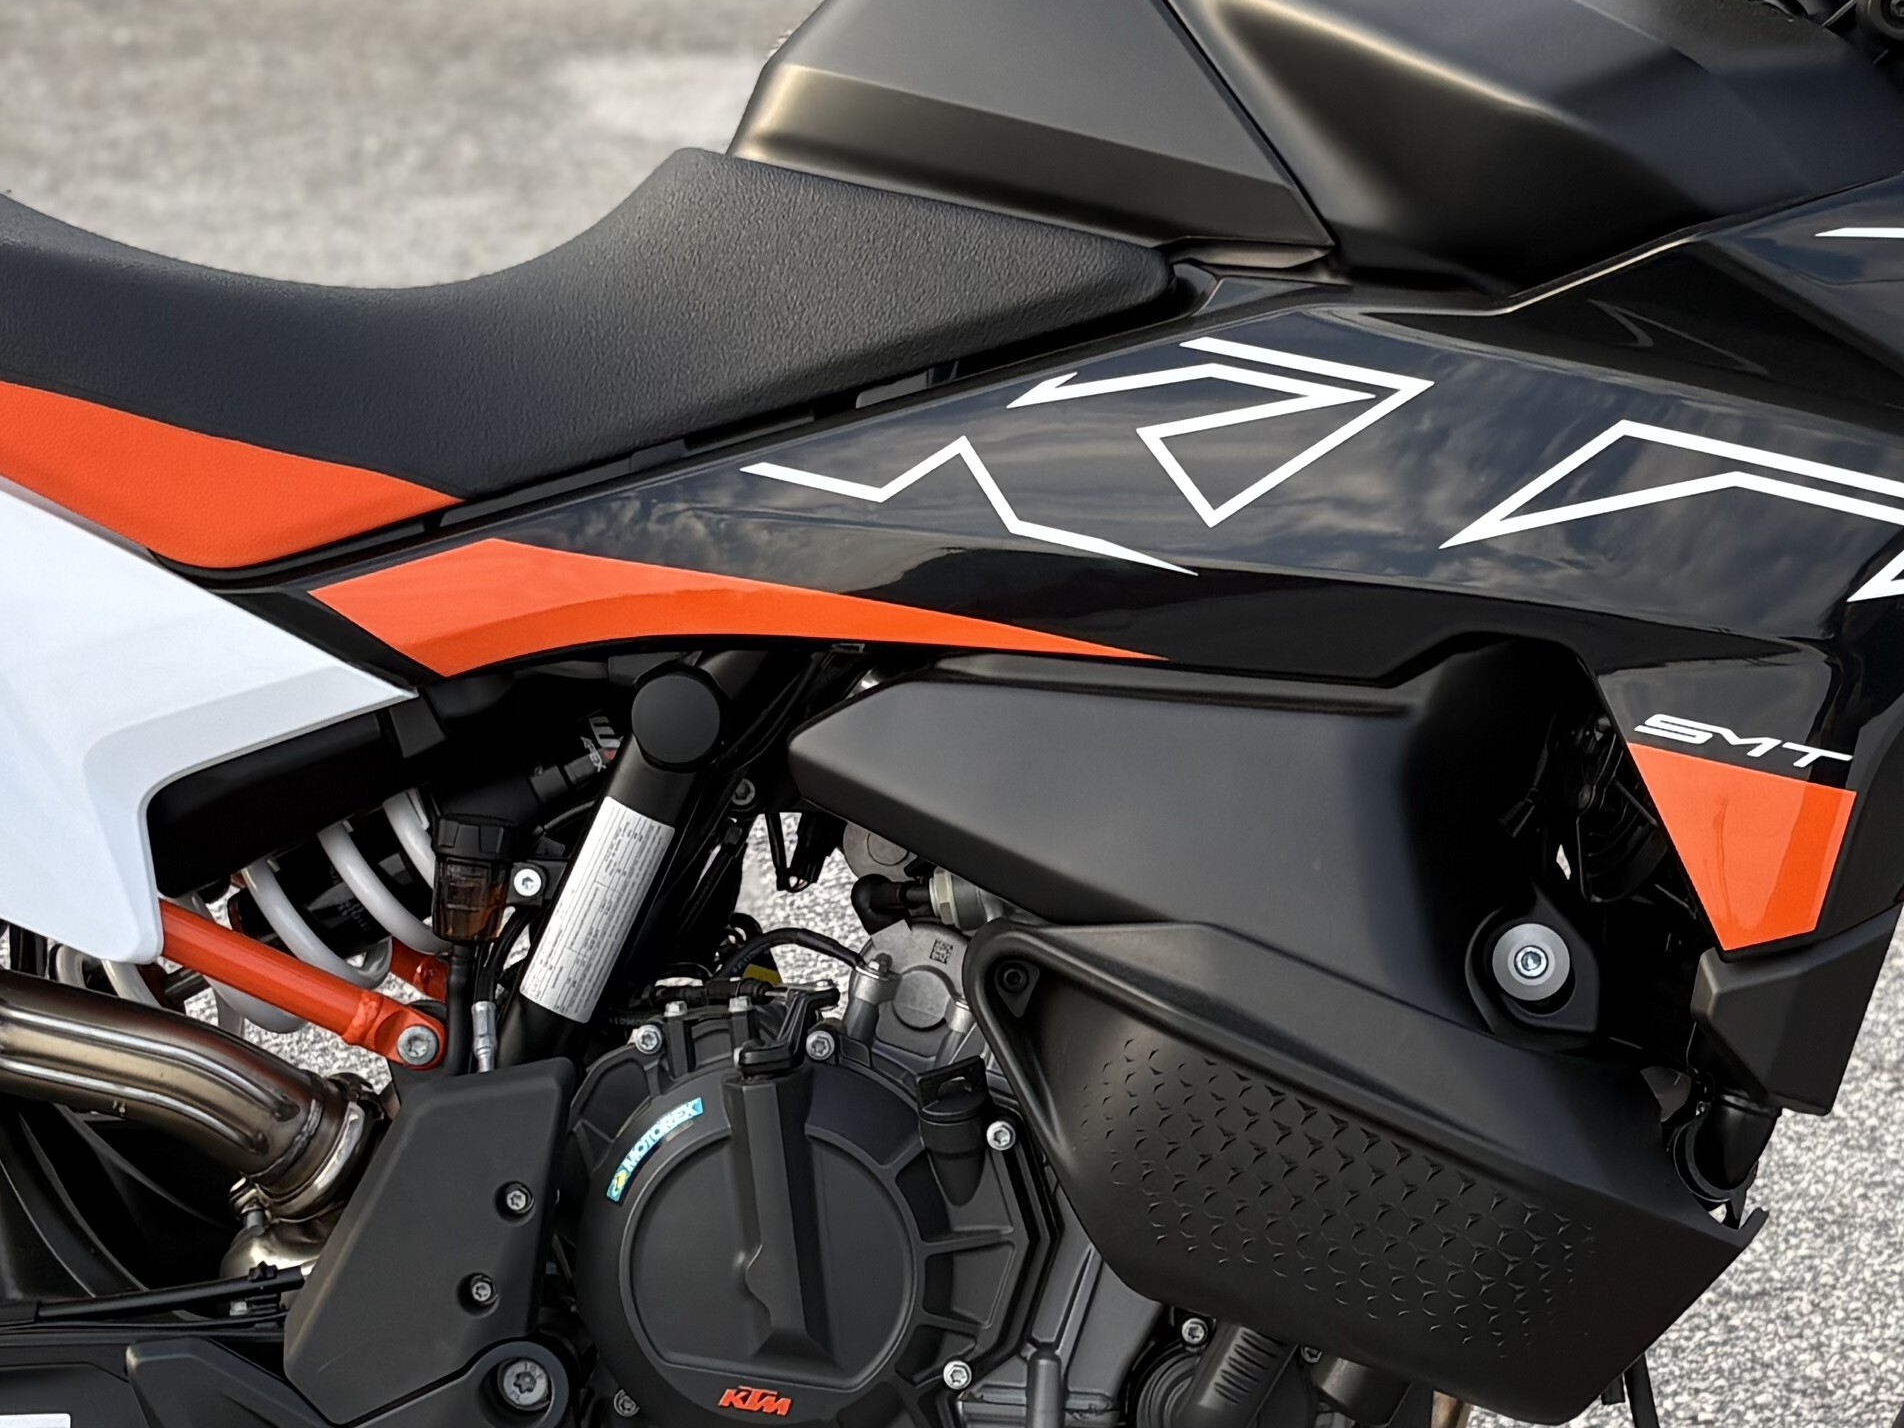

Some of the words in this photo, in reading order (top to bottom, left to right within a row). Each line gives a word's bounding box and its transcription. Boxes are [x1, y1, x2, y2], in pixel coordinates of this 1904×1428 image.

[1633, 713, 1854, 769] SMT
[621, 1100, 698, 1173] MOTOREX
[717, 1384, 792, 1417] KTM
